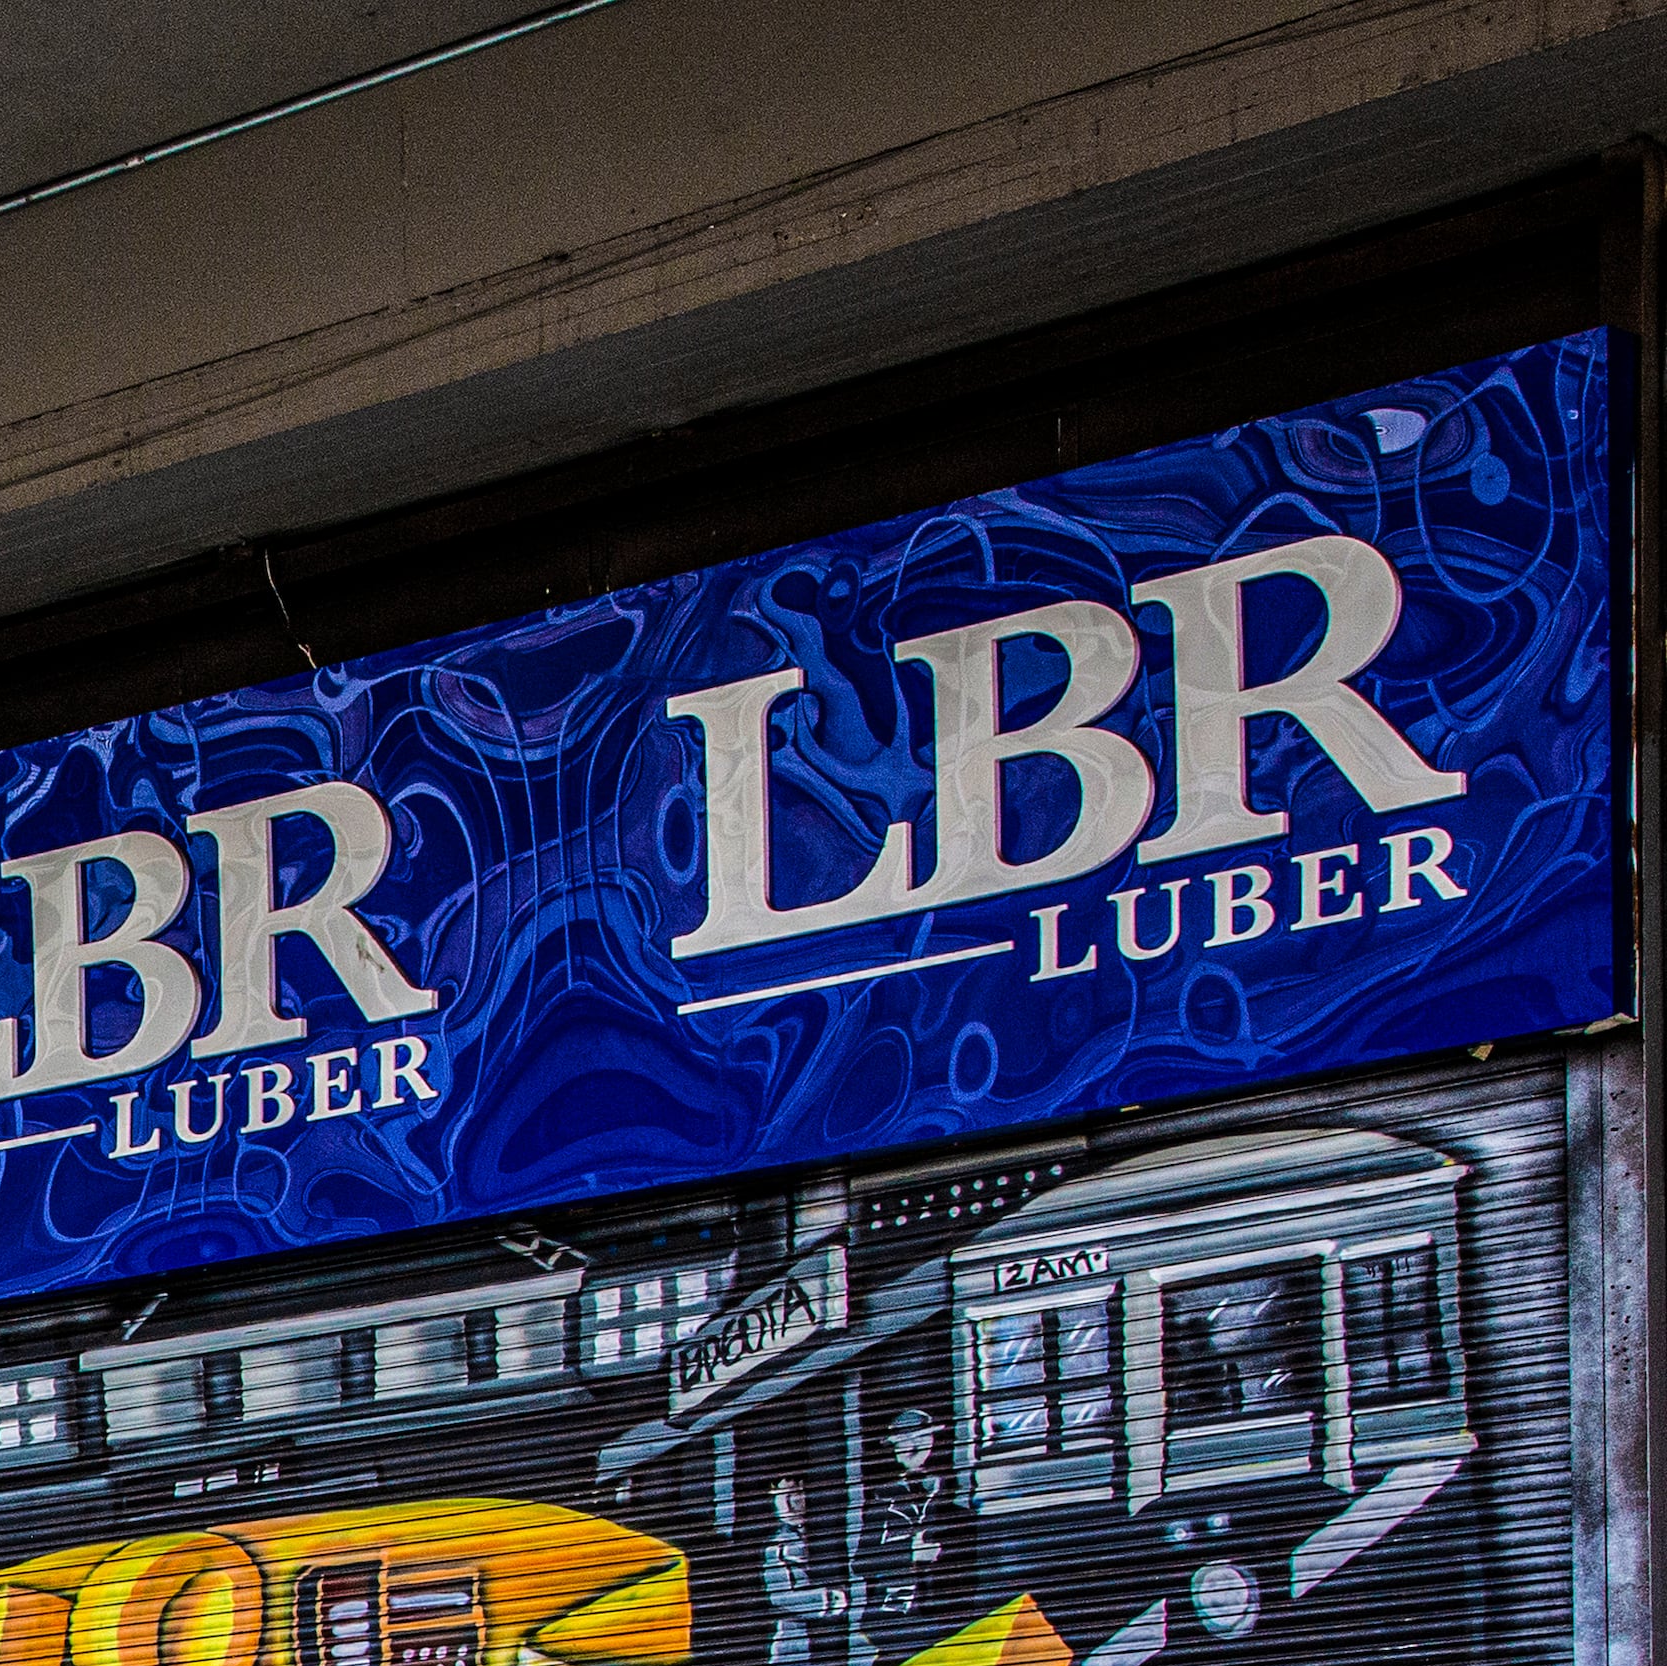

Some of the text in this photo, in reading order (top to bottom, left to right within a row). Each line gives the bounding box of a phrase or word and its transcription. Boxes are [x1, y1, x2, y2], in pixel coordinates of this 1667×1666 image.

[669, 534, 1467, 962] LBR
[1029, 825, 1470, 982] LUBER
[107, 1033, 440, 1162] LUBER
